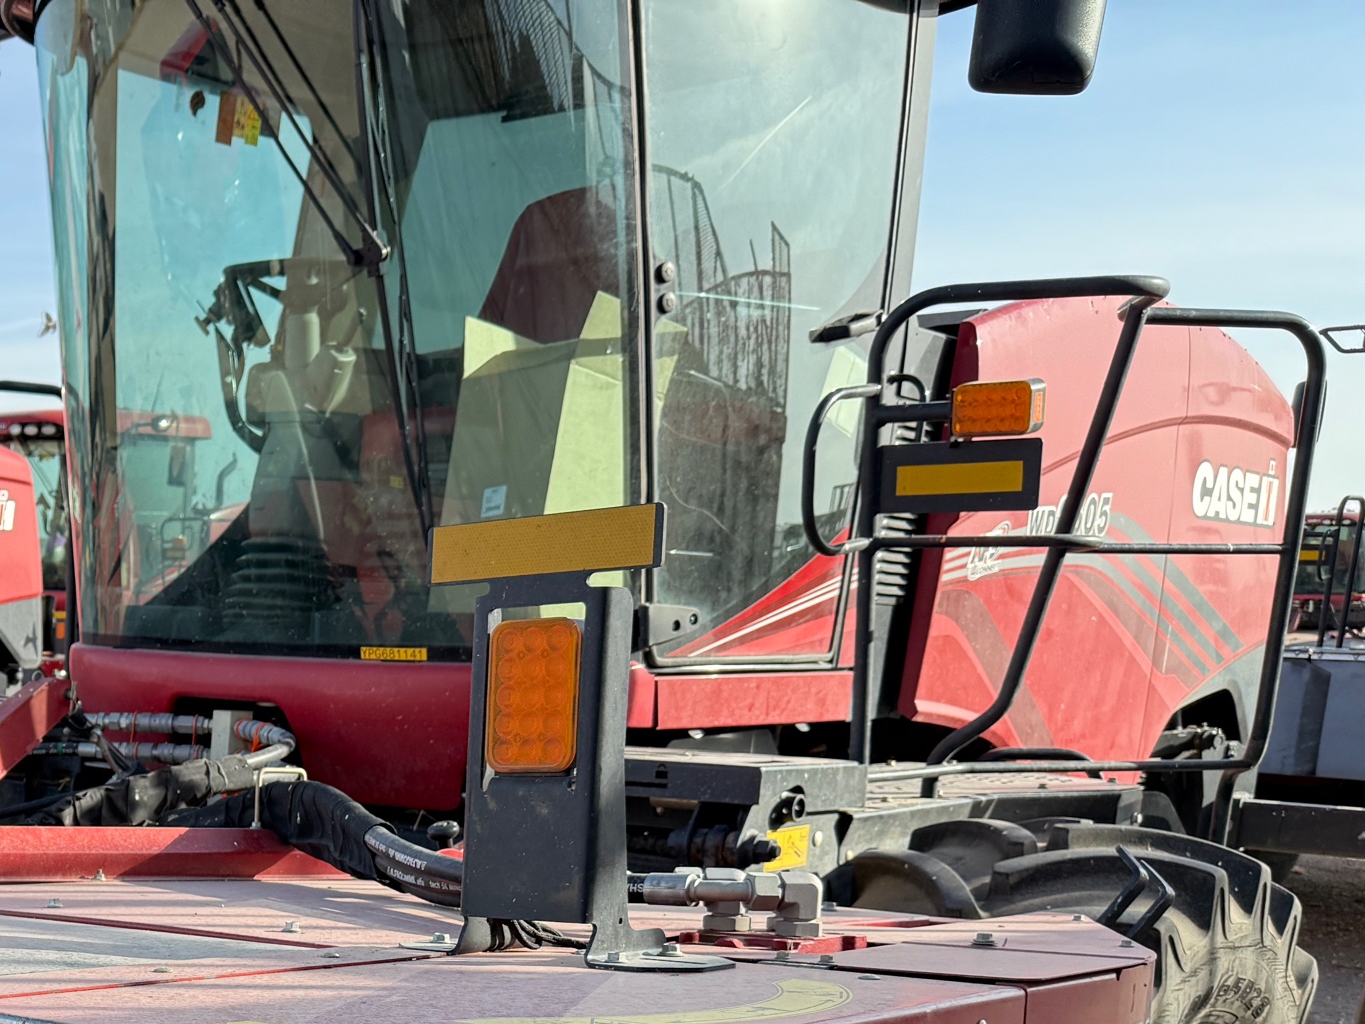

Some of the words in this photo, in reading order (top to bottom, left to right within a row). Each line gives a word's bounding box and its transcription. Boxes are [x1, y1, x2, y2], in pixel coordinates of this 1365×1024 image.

[1027, 492, 1113, 537] WD05
[1192, 460, 1261, 524] CASE
[361, 647, 424, 660] YPG681141
